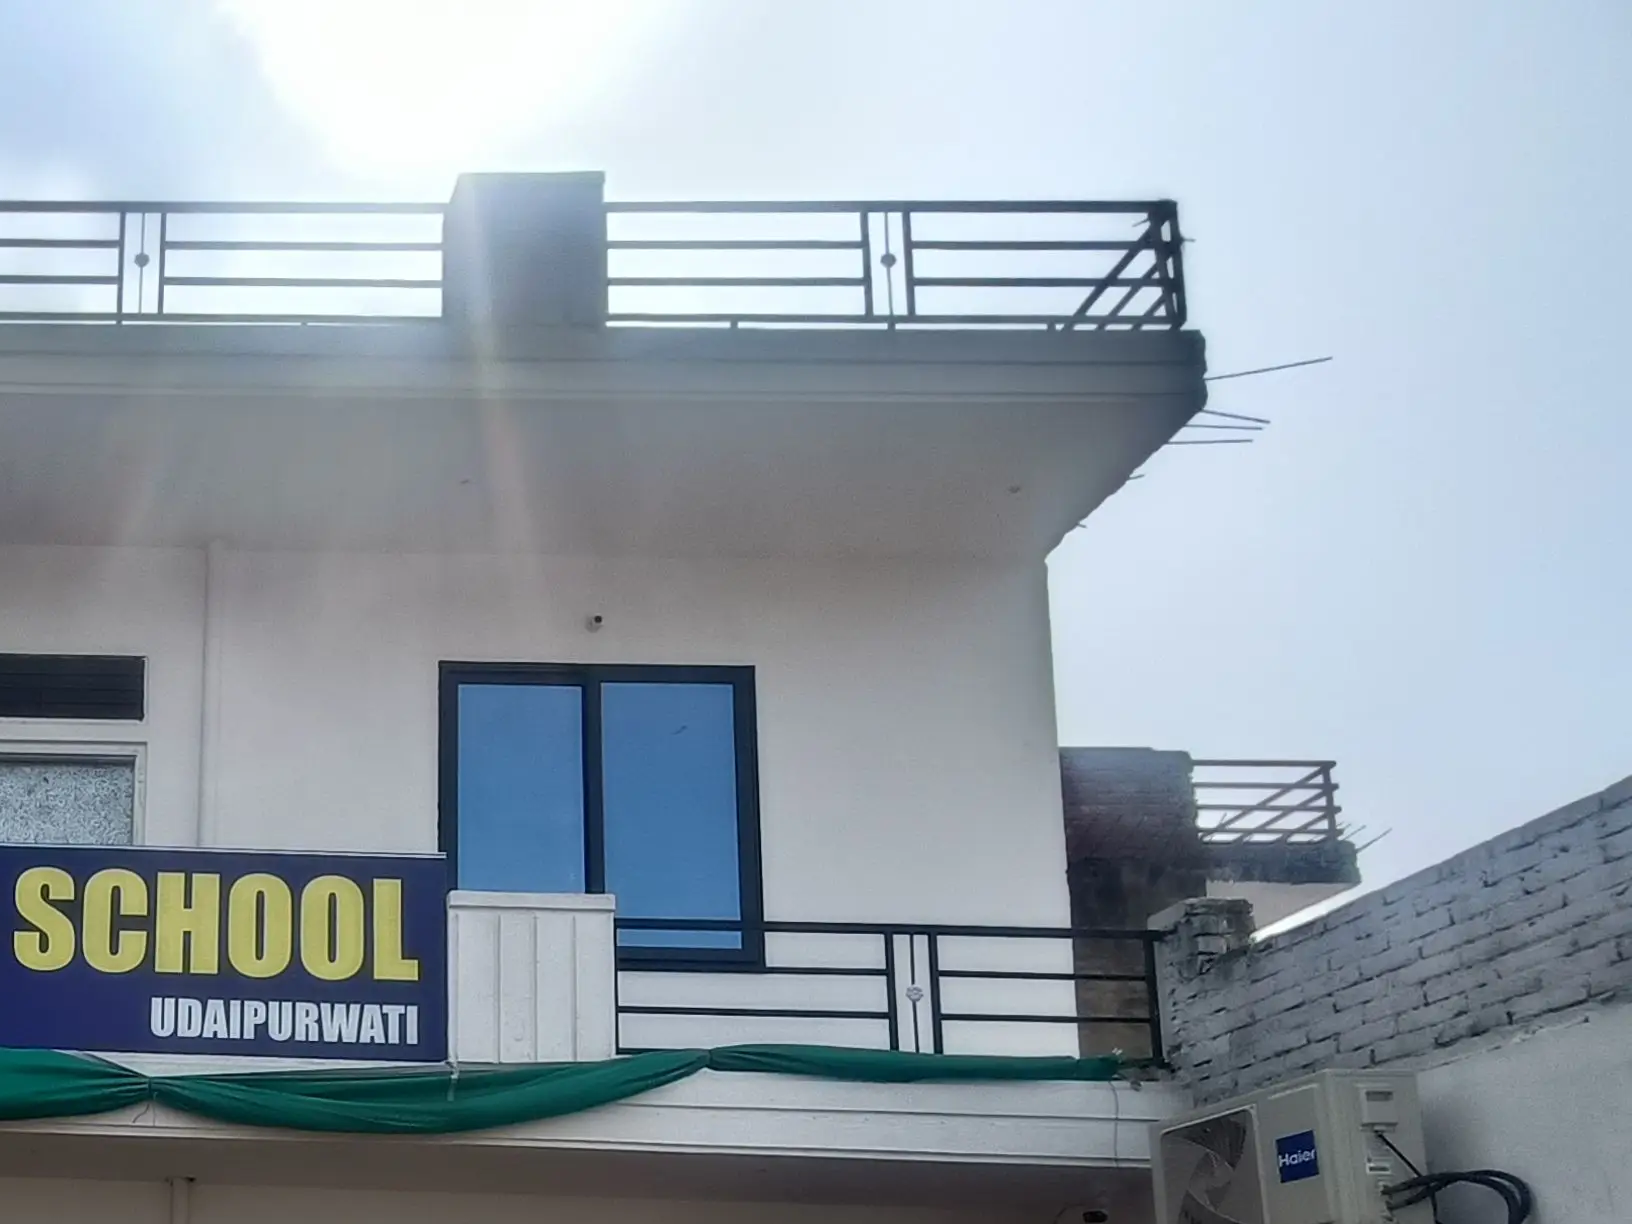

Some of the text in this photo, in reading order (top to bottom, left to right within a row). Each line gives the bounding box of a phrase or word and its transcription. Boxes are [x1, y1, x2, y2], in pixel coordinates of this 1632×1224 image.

[13, 865, 420, 982] SCHOOL
[150, 996, 419, 1046] UDAIPURWATI
[1278, 1149, 1316, 1167] Haier
